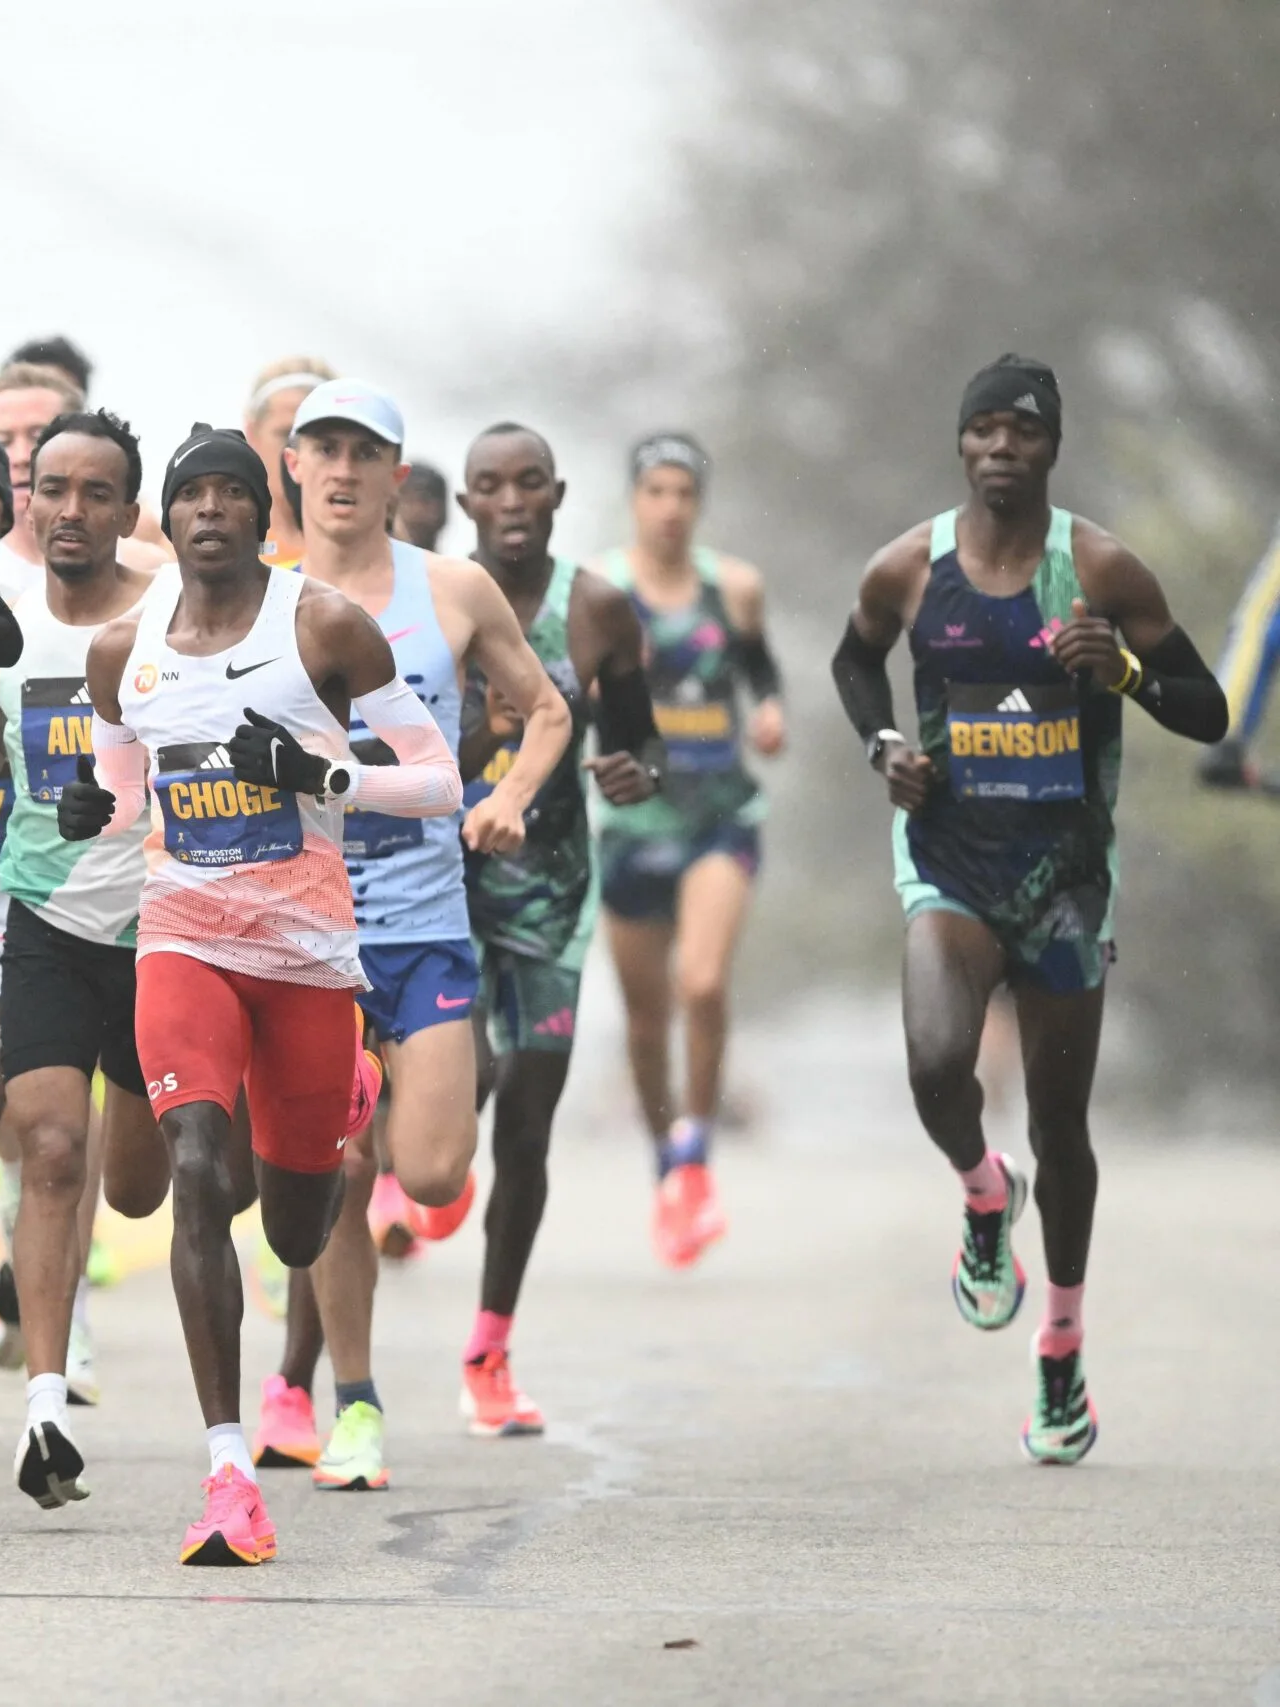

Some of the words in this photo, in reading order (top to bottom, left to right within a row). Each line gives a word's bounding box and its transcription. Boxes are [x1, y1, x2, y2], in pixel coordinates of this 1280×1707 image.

[161, 672, 179, 681] NN
[950, 717, 1079, 759] BENSON
[169, 780, 282, 820] CHOGE
[209, 848, 242, 856] BOSTON
[192, 855, 243, 864] MARATHON
